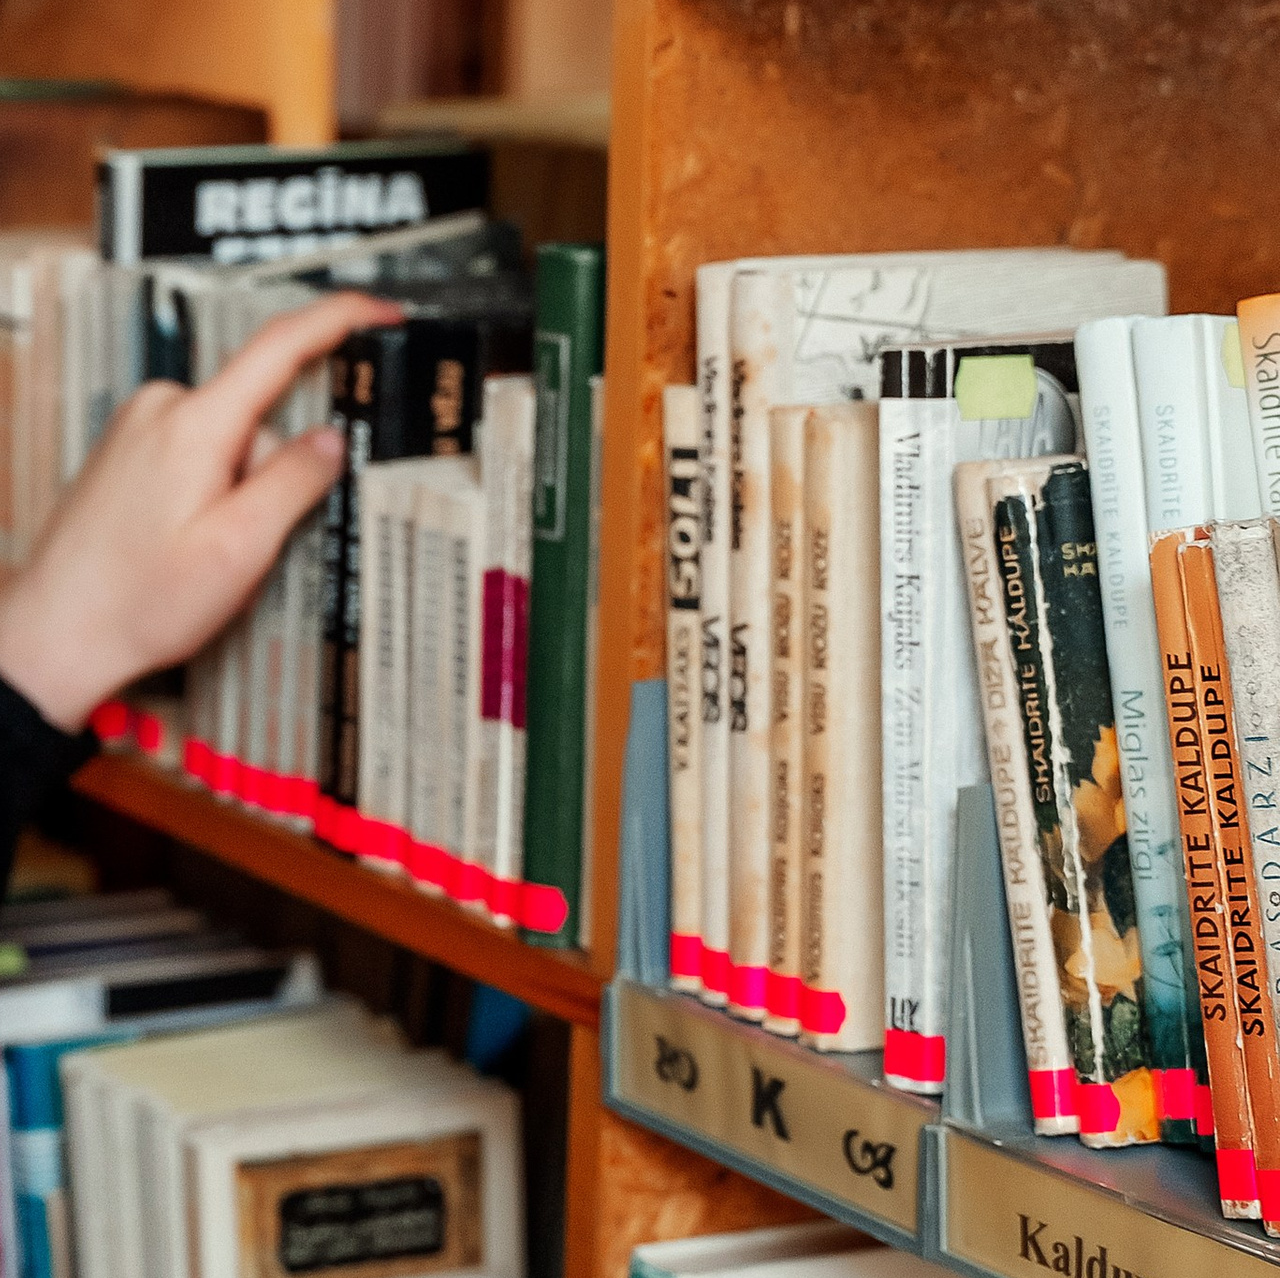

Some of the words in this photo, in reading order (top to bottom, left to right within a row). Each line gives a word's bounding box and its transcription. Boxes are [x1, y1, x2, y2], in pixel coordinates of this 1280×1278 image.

[998, 523, 1032, 651] KALDUPE
[1119, 690, 1150, 800] Miglas
[1167, 651, 1210, 817] KALDUPE
[1201, 663, 1240, 828] KALDUPE
[1128, 809, 1160, 881] zirgi
[1184, 833, 1227, 1022] SKAIDRITE
[1219, 846, 1265, 1037] SKAIDRITE
[750, 1063, 791, 1142] K
